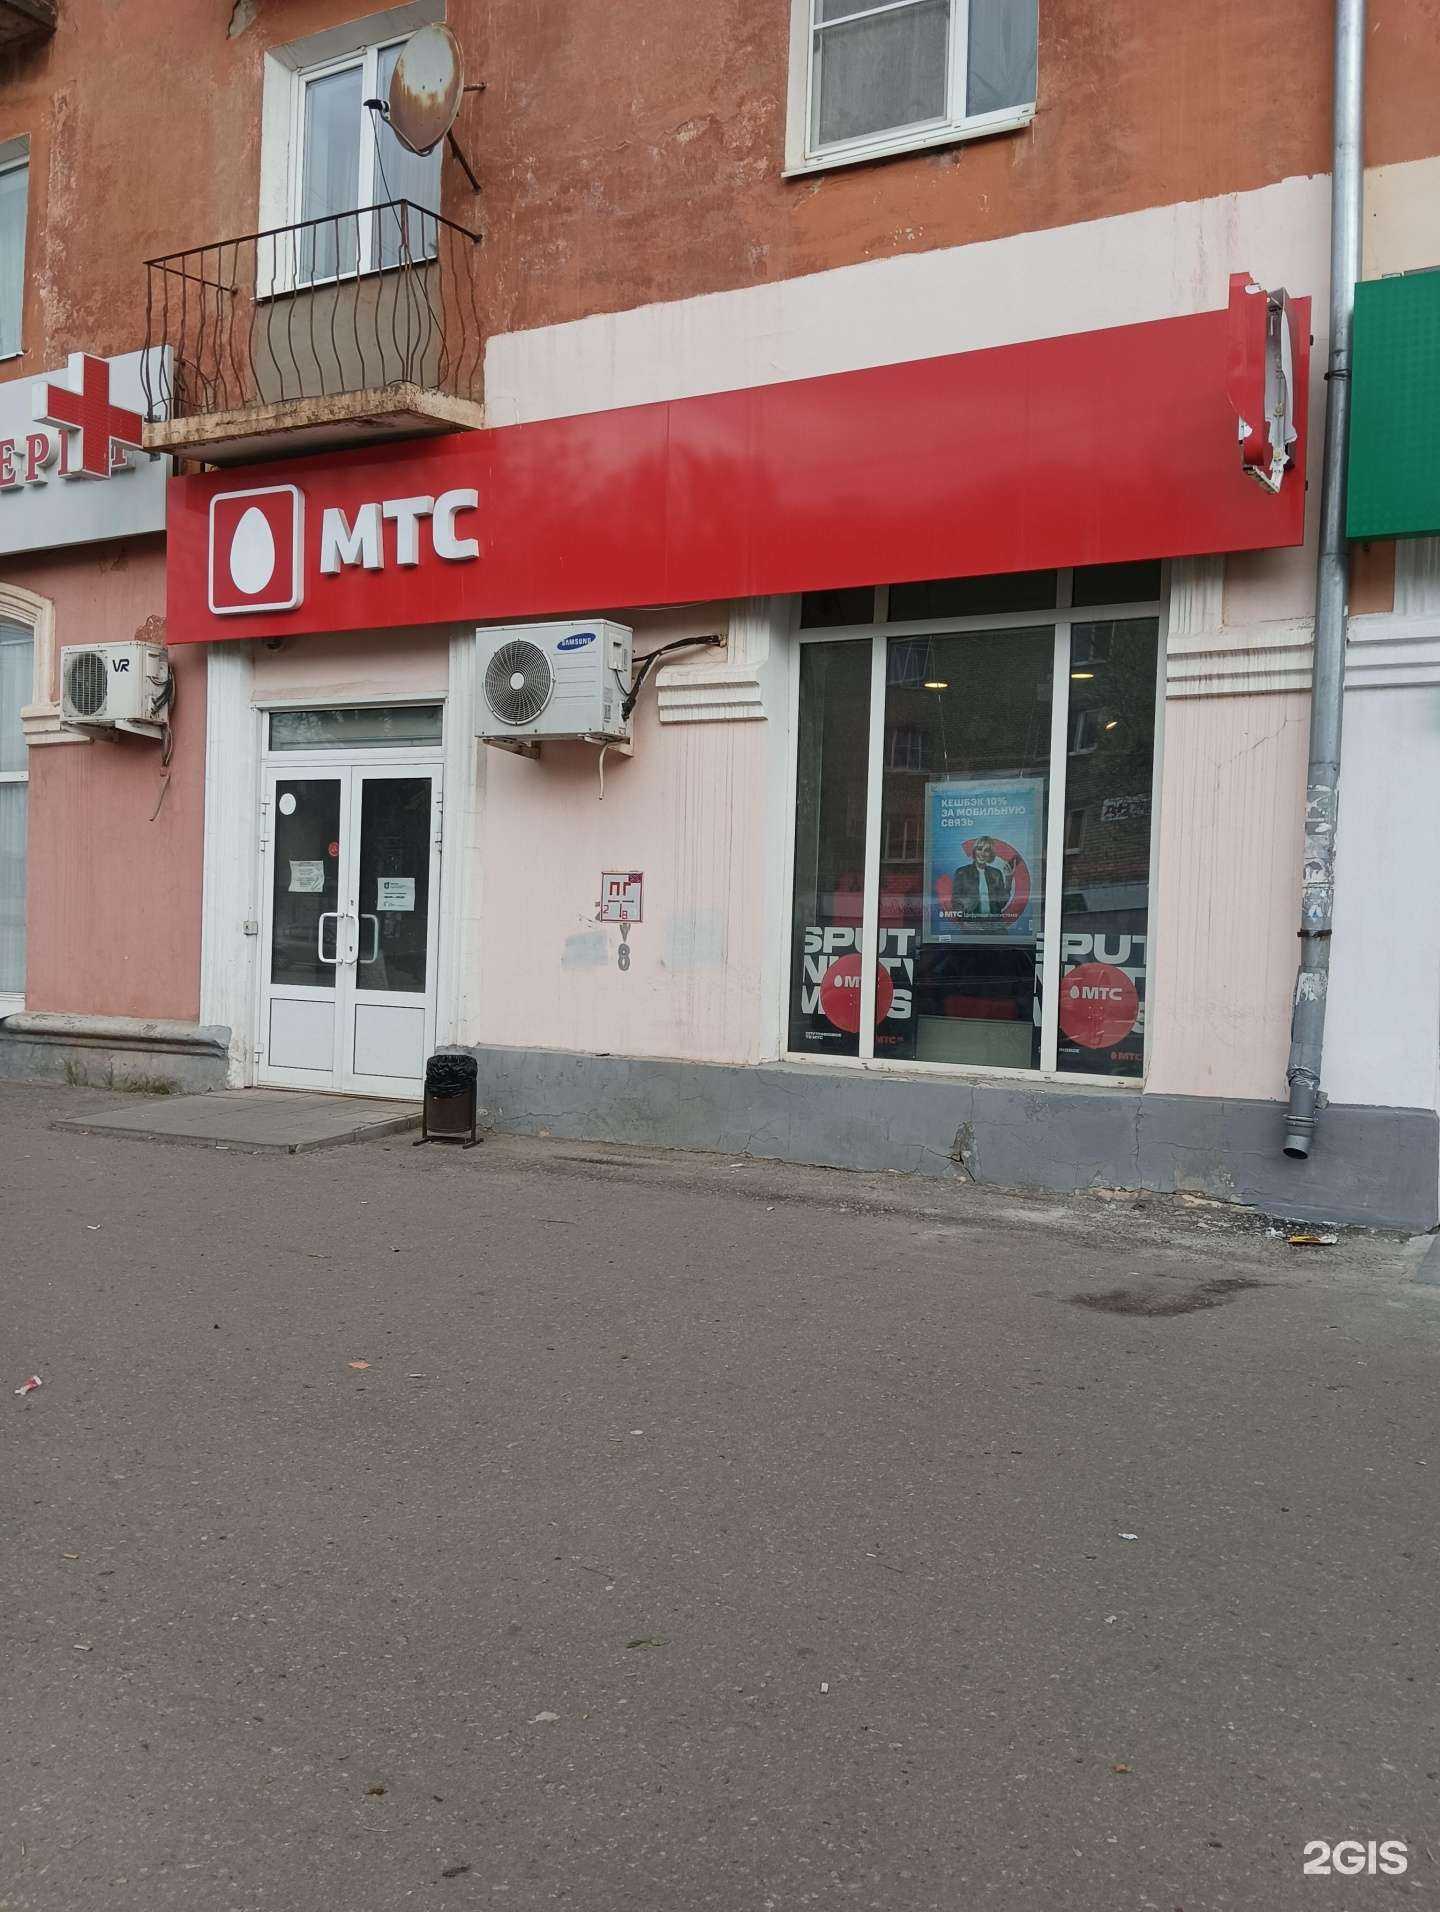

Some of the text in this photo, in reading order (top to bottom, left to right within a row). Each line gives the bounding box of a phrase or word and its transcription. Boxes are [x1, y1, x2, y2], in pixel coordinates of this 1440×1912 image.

[320, 488, 480, 575] МТС
[561, 637, 592, 647] SAMSUNG
[112, 658, 130, 672] VR
[941, 796, 1008, 807] КЕШБЭК 10%
[941, 806, 1026, 818] ЗА МОБИЛЬНУЮ
[941, 817, 974, 827] СВЯЗЬ
[609, 881, 631, 896] ПГ
[944, 910, 963, 918] МТС
[1082, 985, 1123, 1000] МТС
